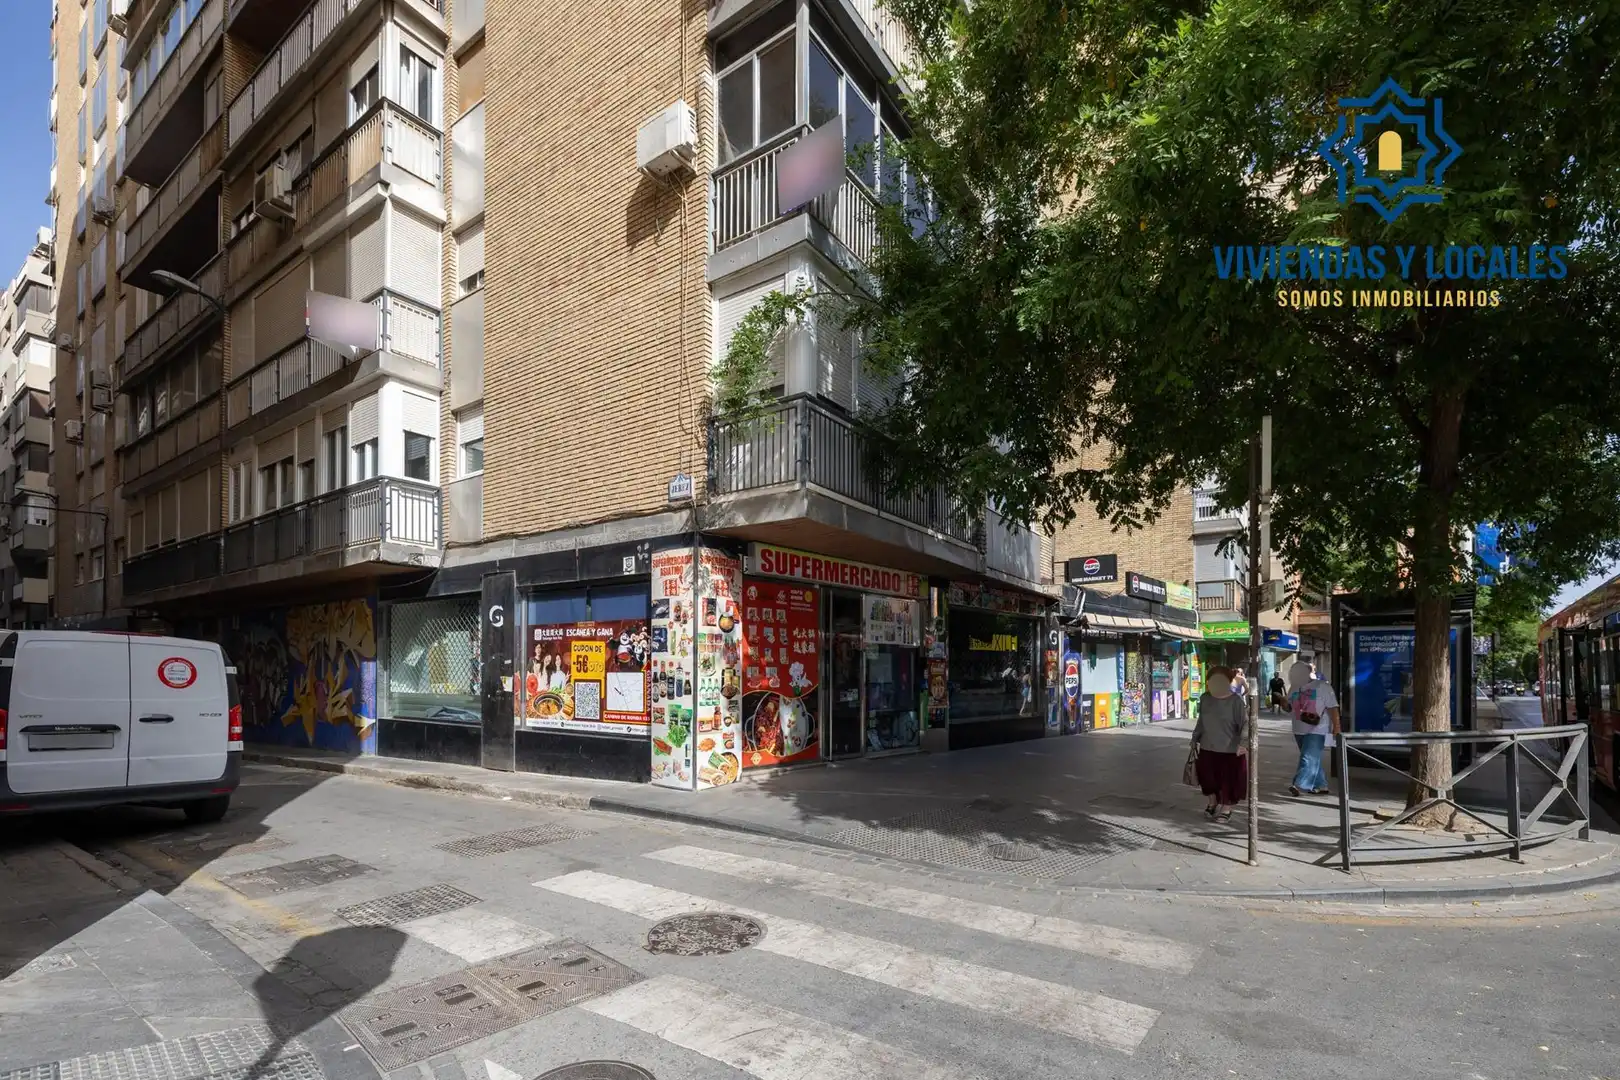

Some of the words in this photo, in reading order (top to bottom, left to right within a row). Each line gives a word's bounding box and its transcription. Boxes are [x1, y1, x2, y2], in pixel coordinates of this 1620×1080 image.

[760, 548, 900, 592] SUPERMERCADO
[566, 628, 590, 637] ESCANEA
[597, 628, 613, 636] GANA
[1049, 630, 1058, 645] G
